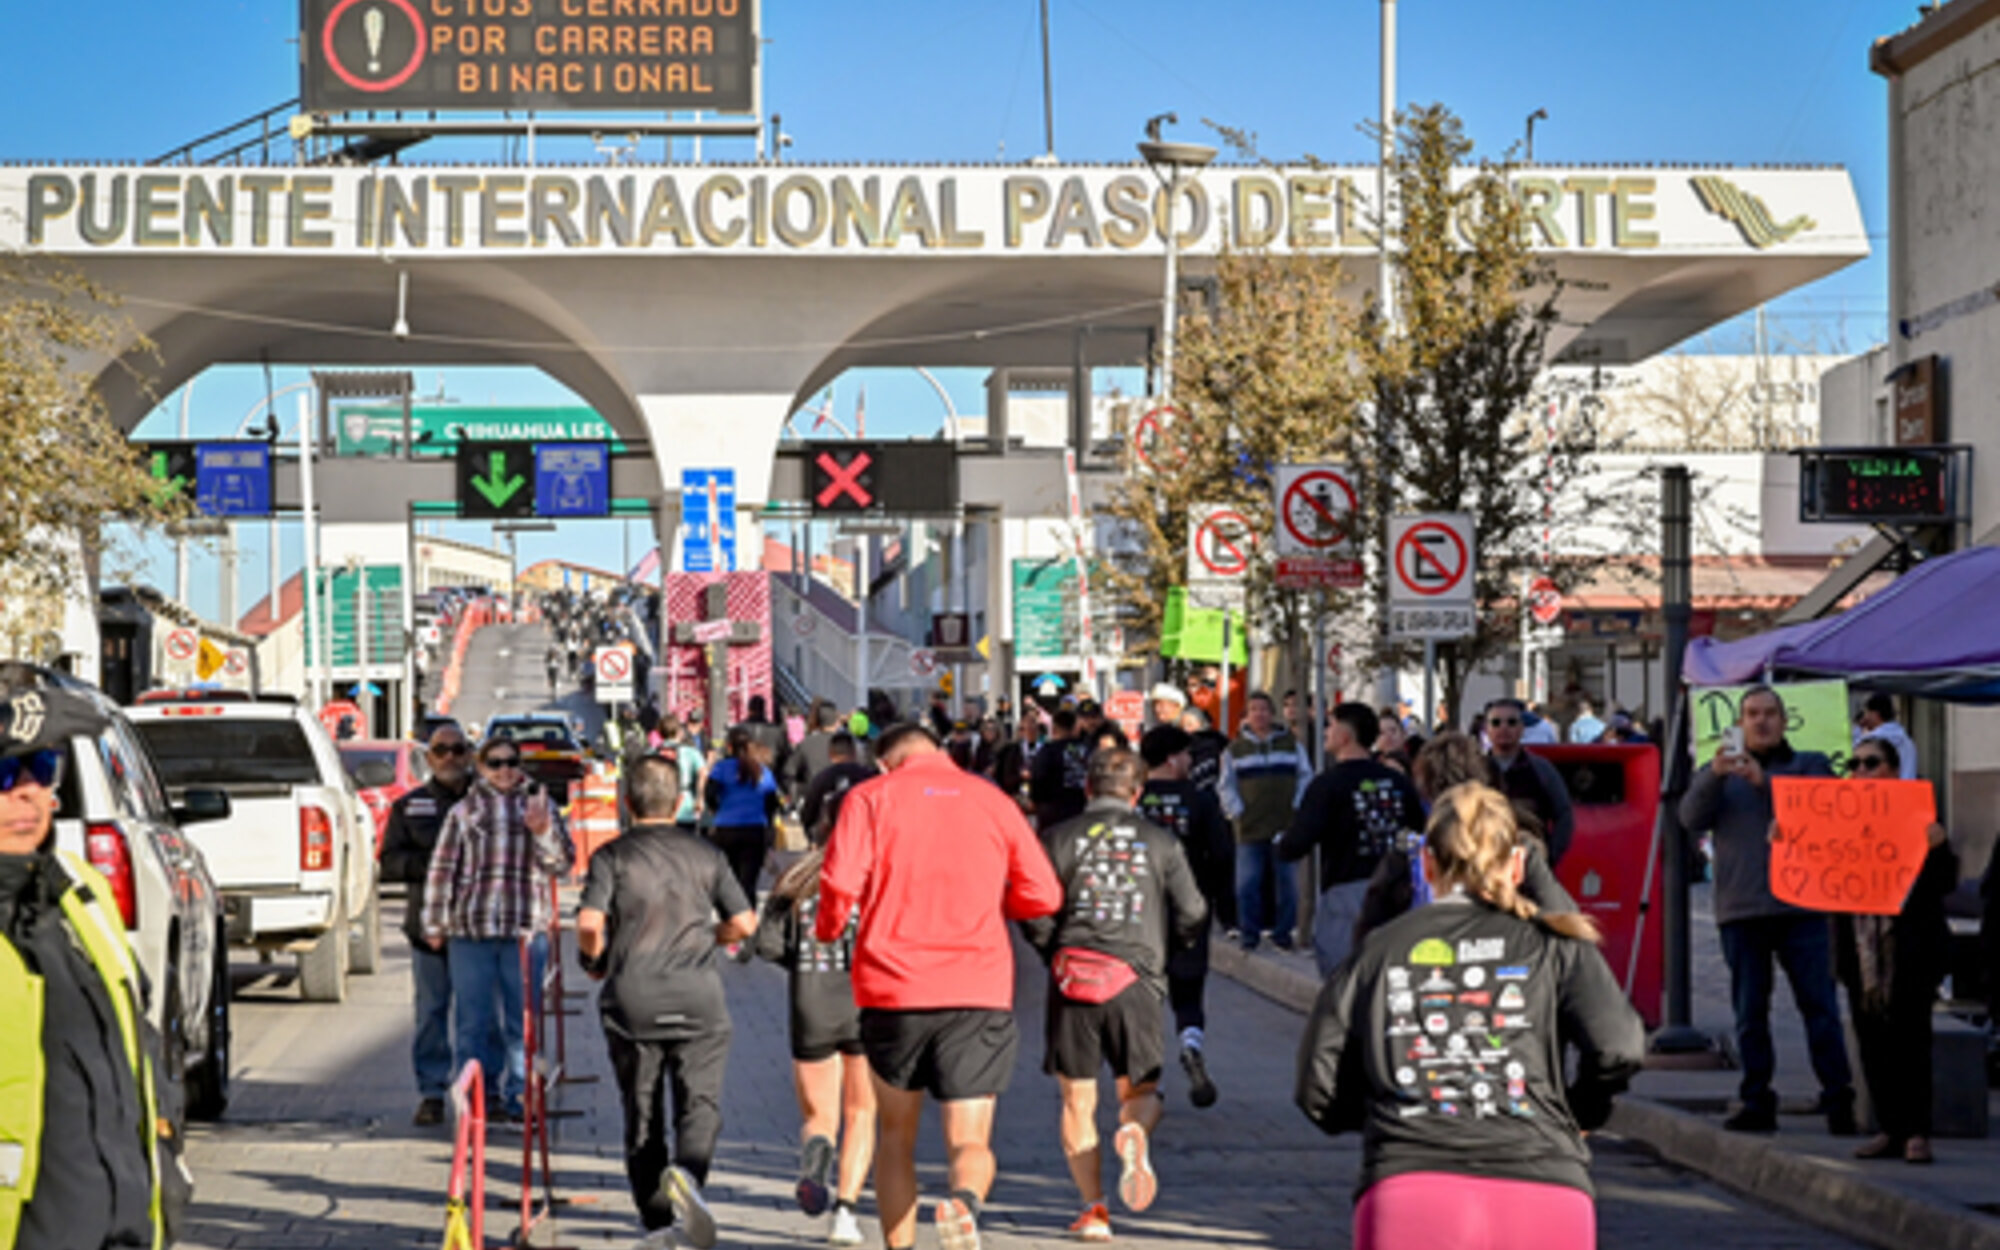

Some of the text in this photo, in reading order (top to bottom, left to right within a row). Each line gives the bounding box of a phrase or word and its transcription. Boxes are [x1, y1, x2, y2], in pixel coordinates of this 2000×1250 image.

[561, 0, 739, 17] CERRADO
[431, 25, 714, 55] POR CARRERA
[458, 63, 713, 93] BINACIONAL
[27, 173, 1660, 249] PUENTE INTERNACIONAL PASO DEL ORTE
